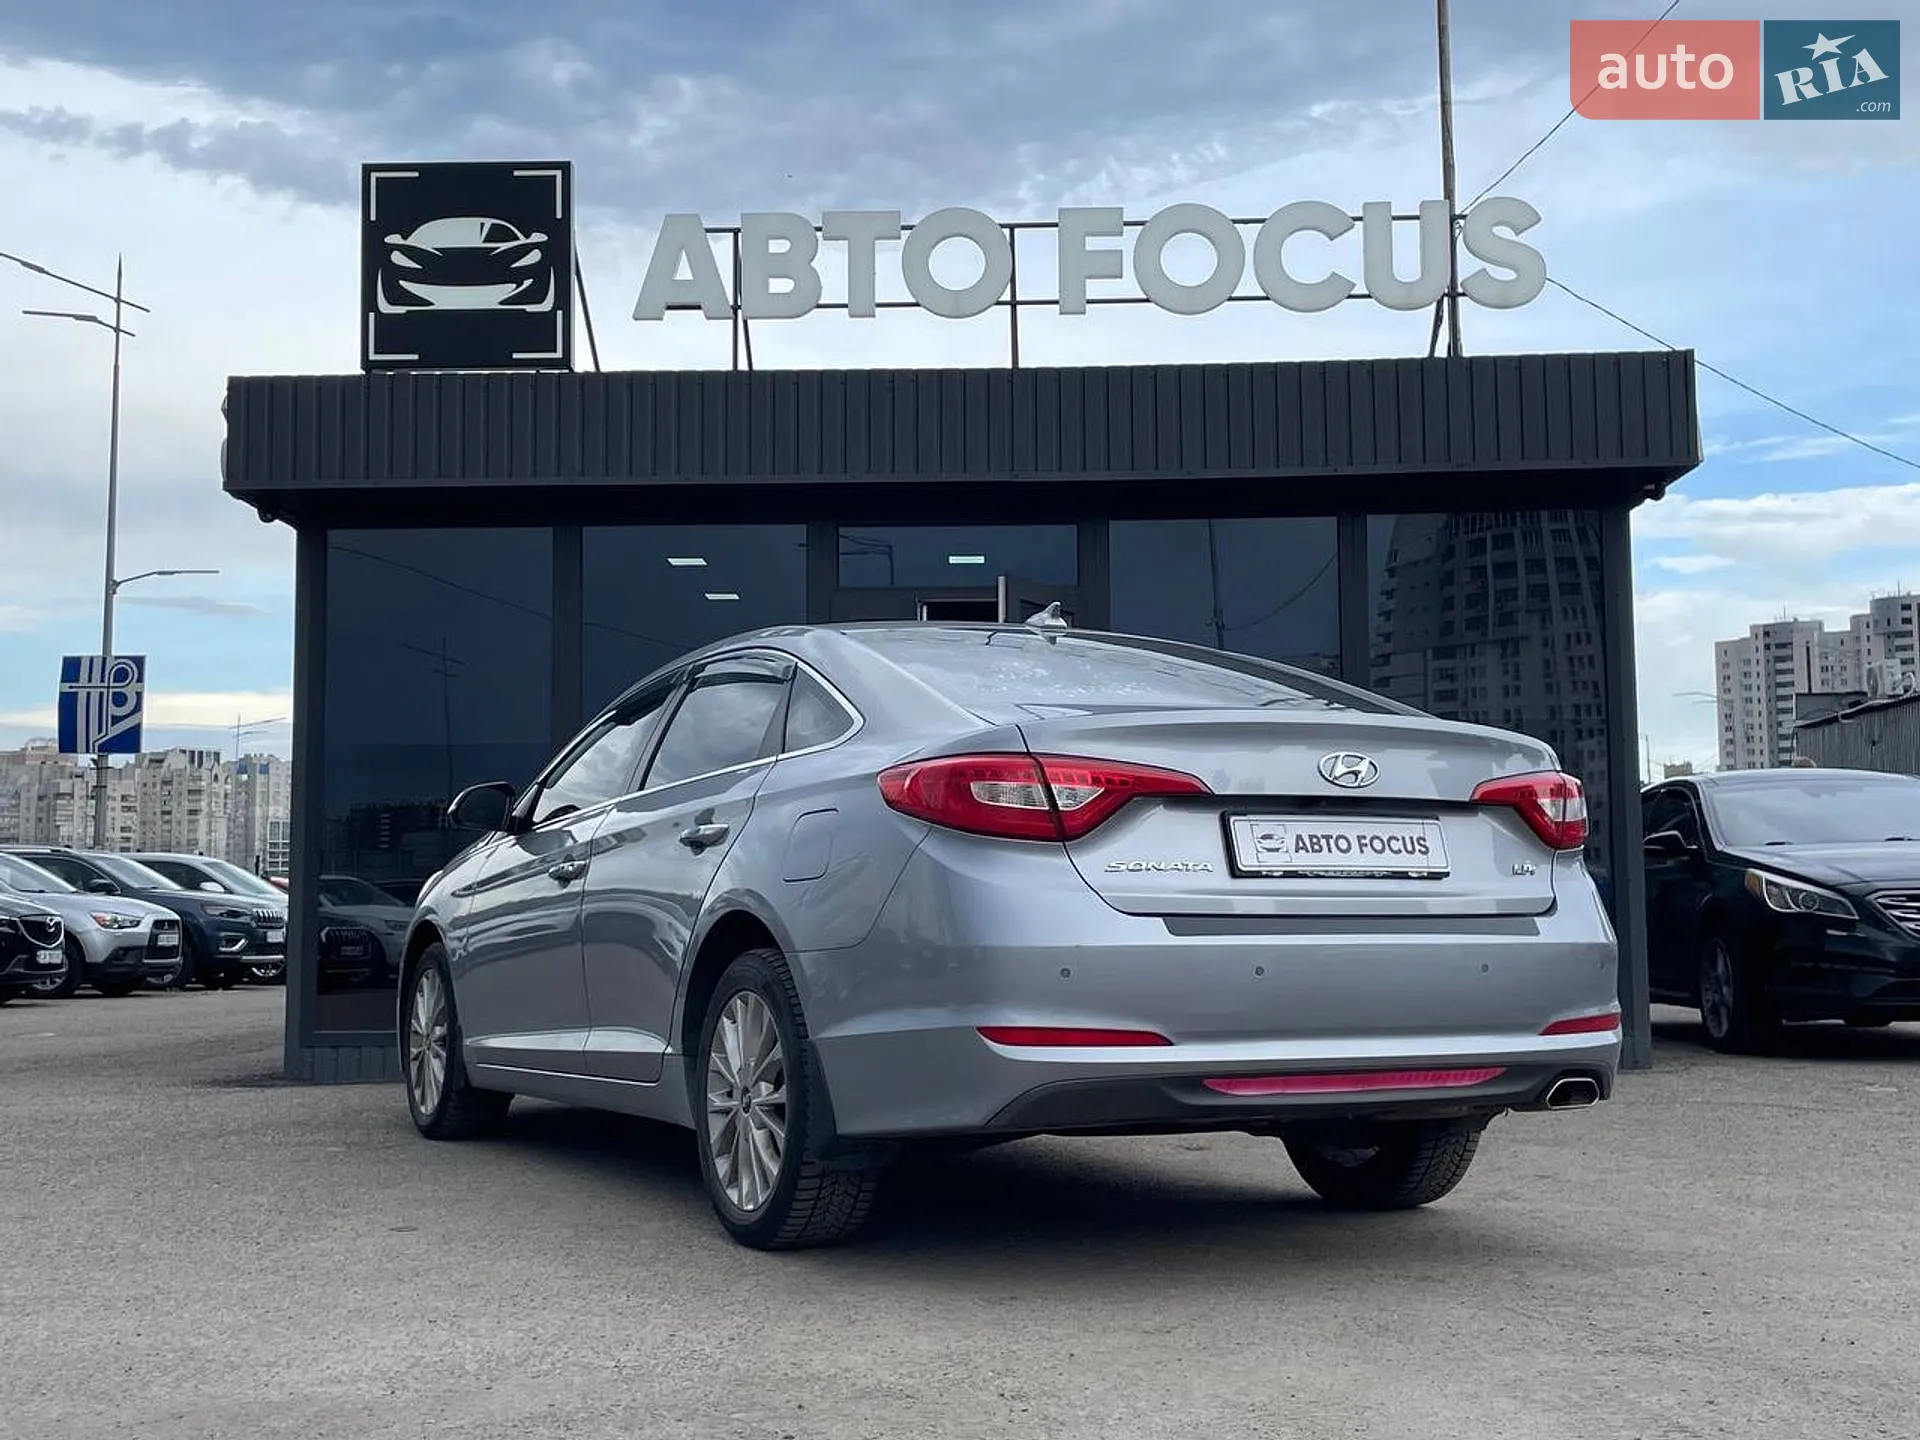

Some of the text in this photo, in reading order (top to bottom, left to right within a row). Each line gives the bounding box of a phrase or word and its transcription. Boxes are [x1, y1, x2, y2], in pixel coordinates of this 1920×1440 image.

[632, 196, 1548, 321] АВТО FOCUS
[1294, 833, 1430, 855] АВТО FOCUS
[1104, 860, 1214, 873] SONATA
